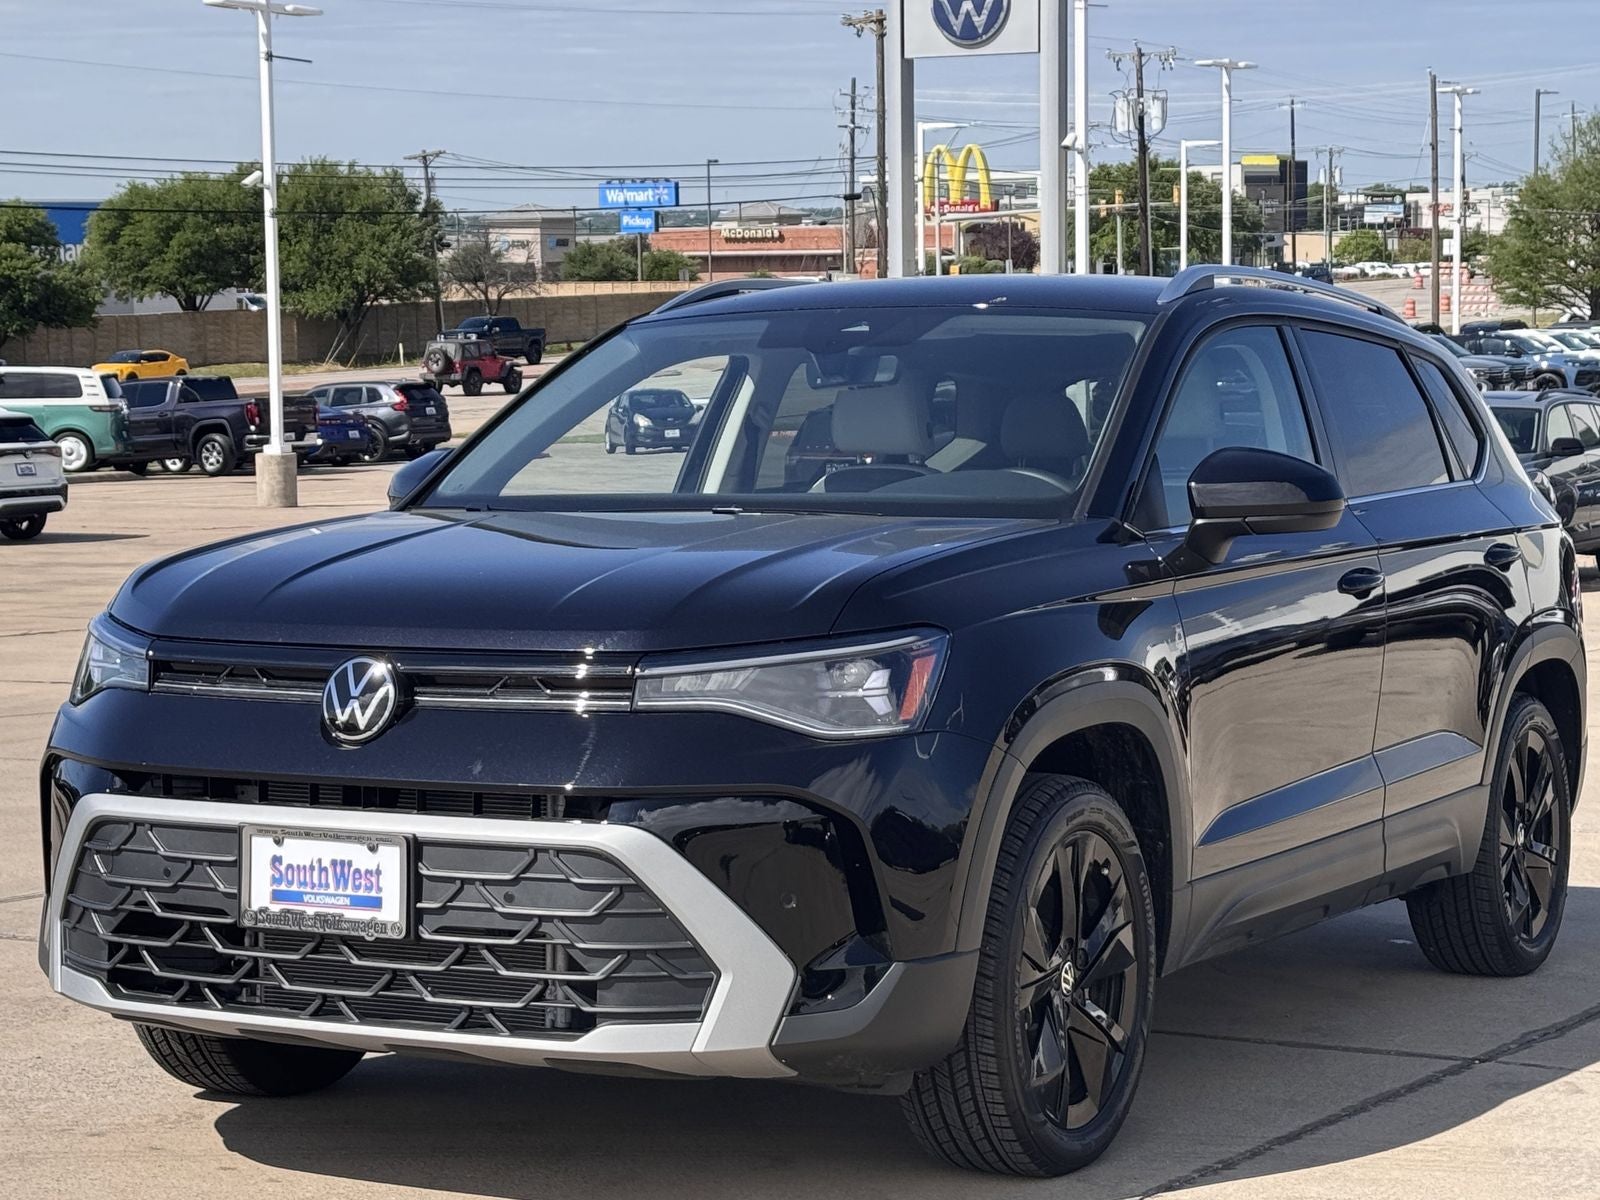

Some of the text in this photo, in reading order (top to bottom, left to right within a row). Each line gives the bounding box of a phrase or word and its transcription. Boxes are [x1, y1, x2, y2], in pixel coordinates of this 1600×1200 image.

[606, 187, 653, 203] Walmart
[623, 215, 652, 228] Pickup
[720, 228, 780, 239] McDonald's
[269, 853, 383, 894] SouthWest
[303, 893, 350, 906] VOLKSWAGEN
